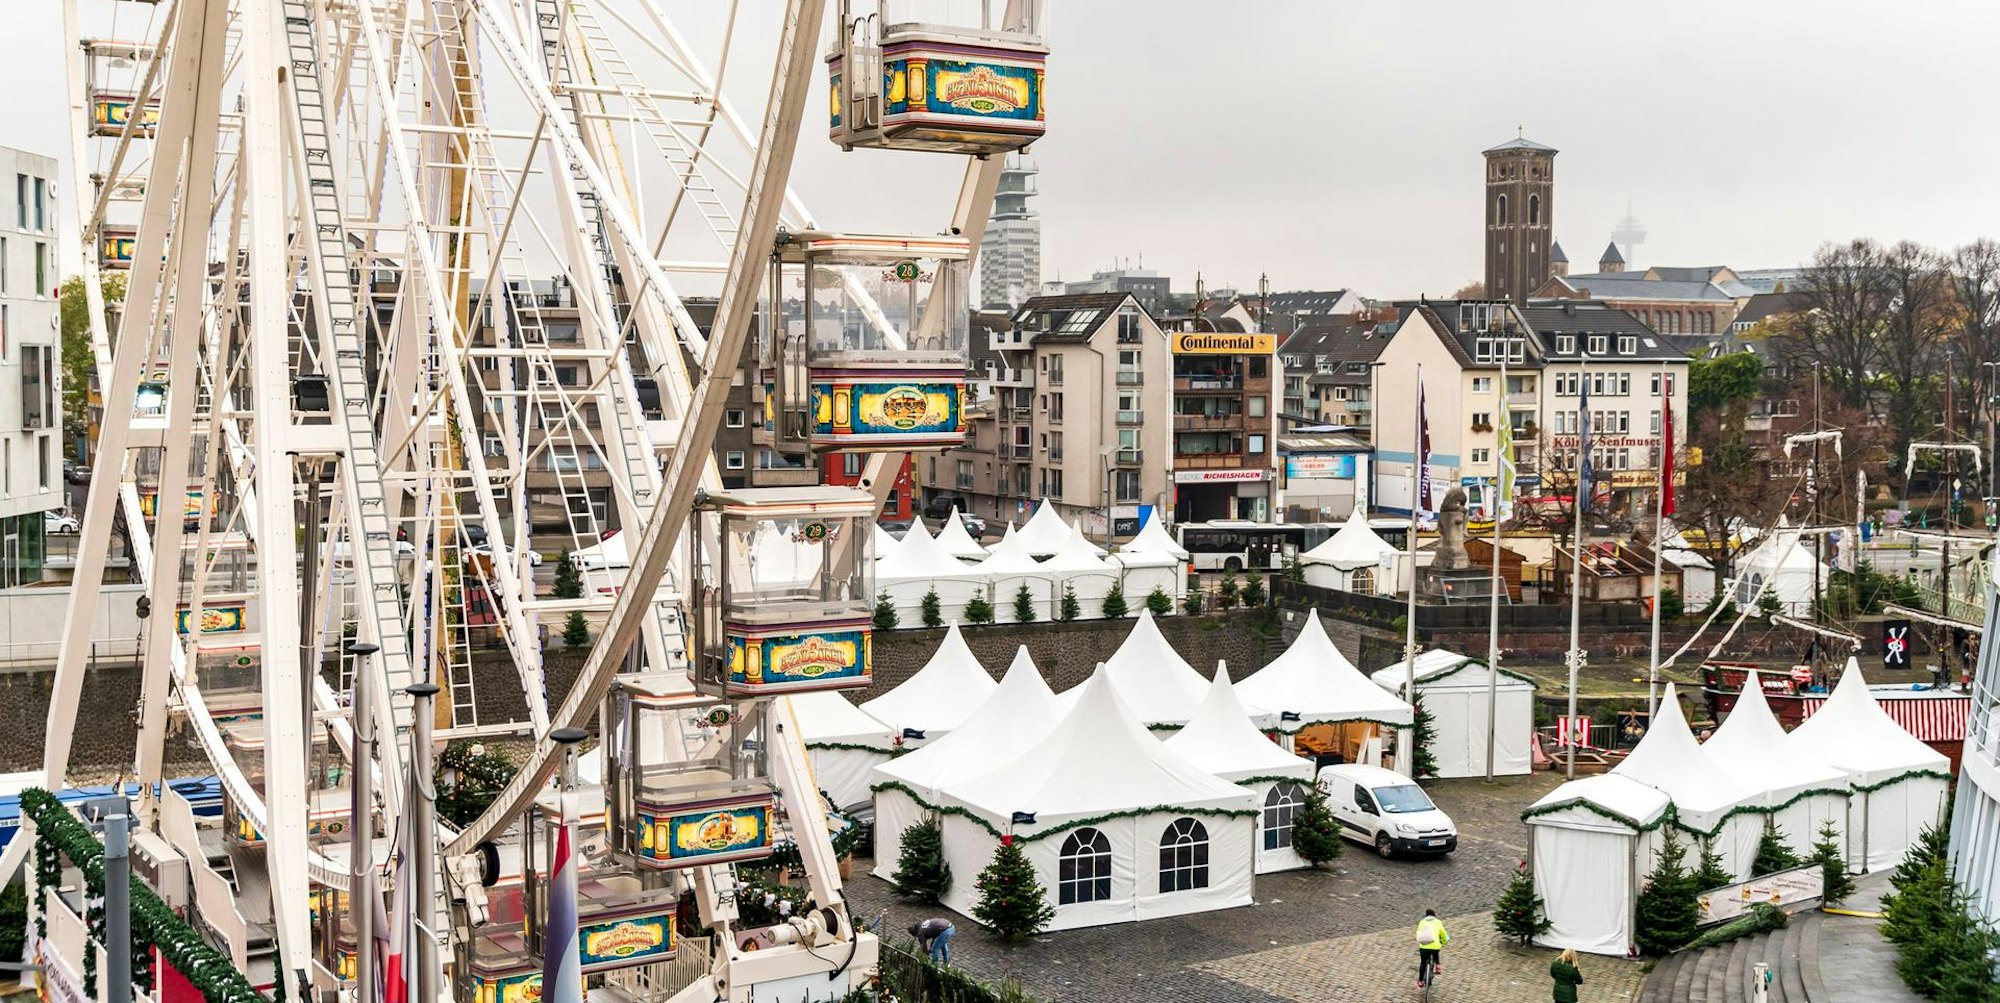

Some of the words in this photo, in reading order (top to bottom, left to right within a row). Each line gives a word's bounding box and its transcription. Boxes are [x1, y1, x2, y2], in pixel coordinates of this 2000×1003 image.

[902, 265, 913, 276] 28
[1180, 335, 1254, 351] Continental
[1203, 472, 1260, 480] RICHELSHAGEN
[810, 525, 821, 537] 29
[714, 711, 725, 722] 30
